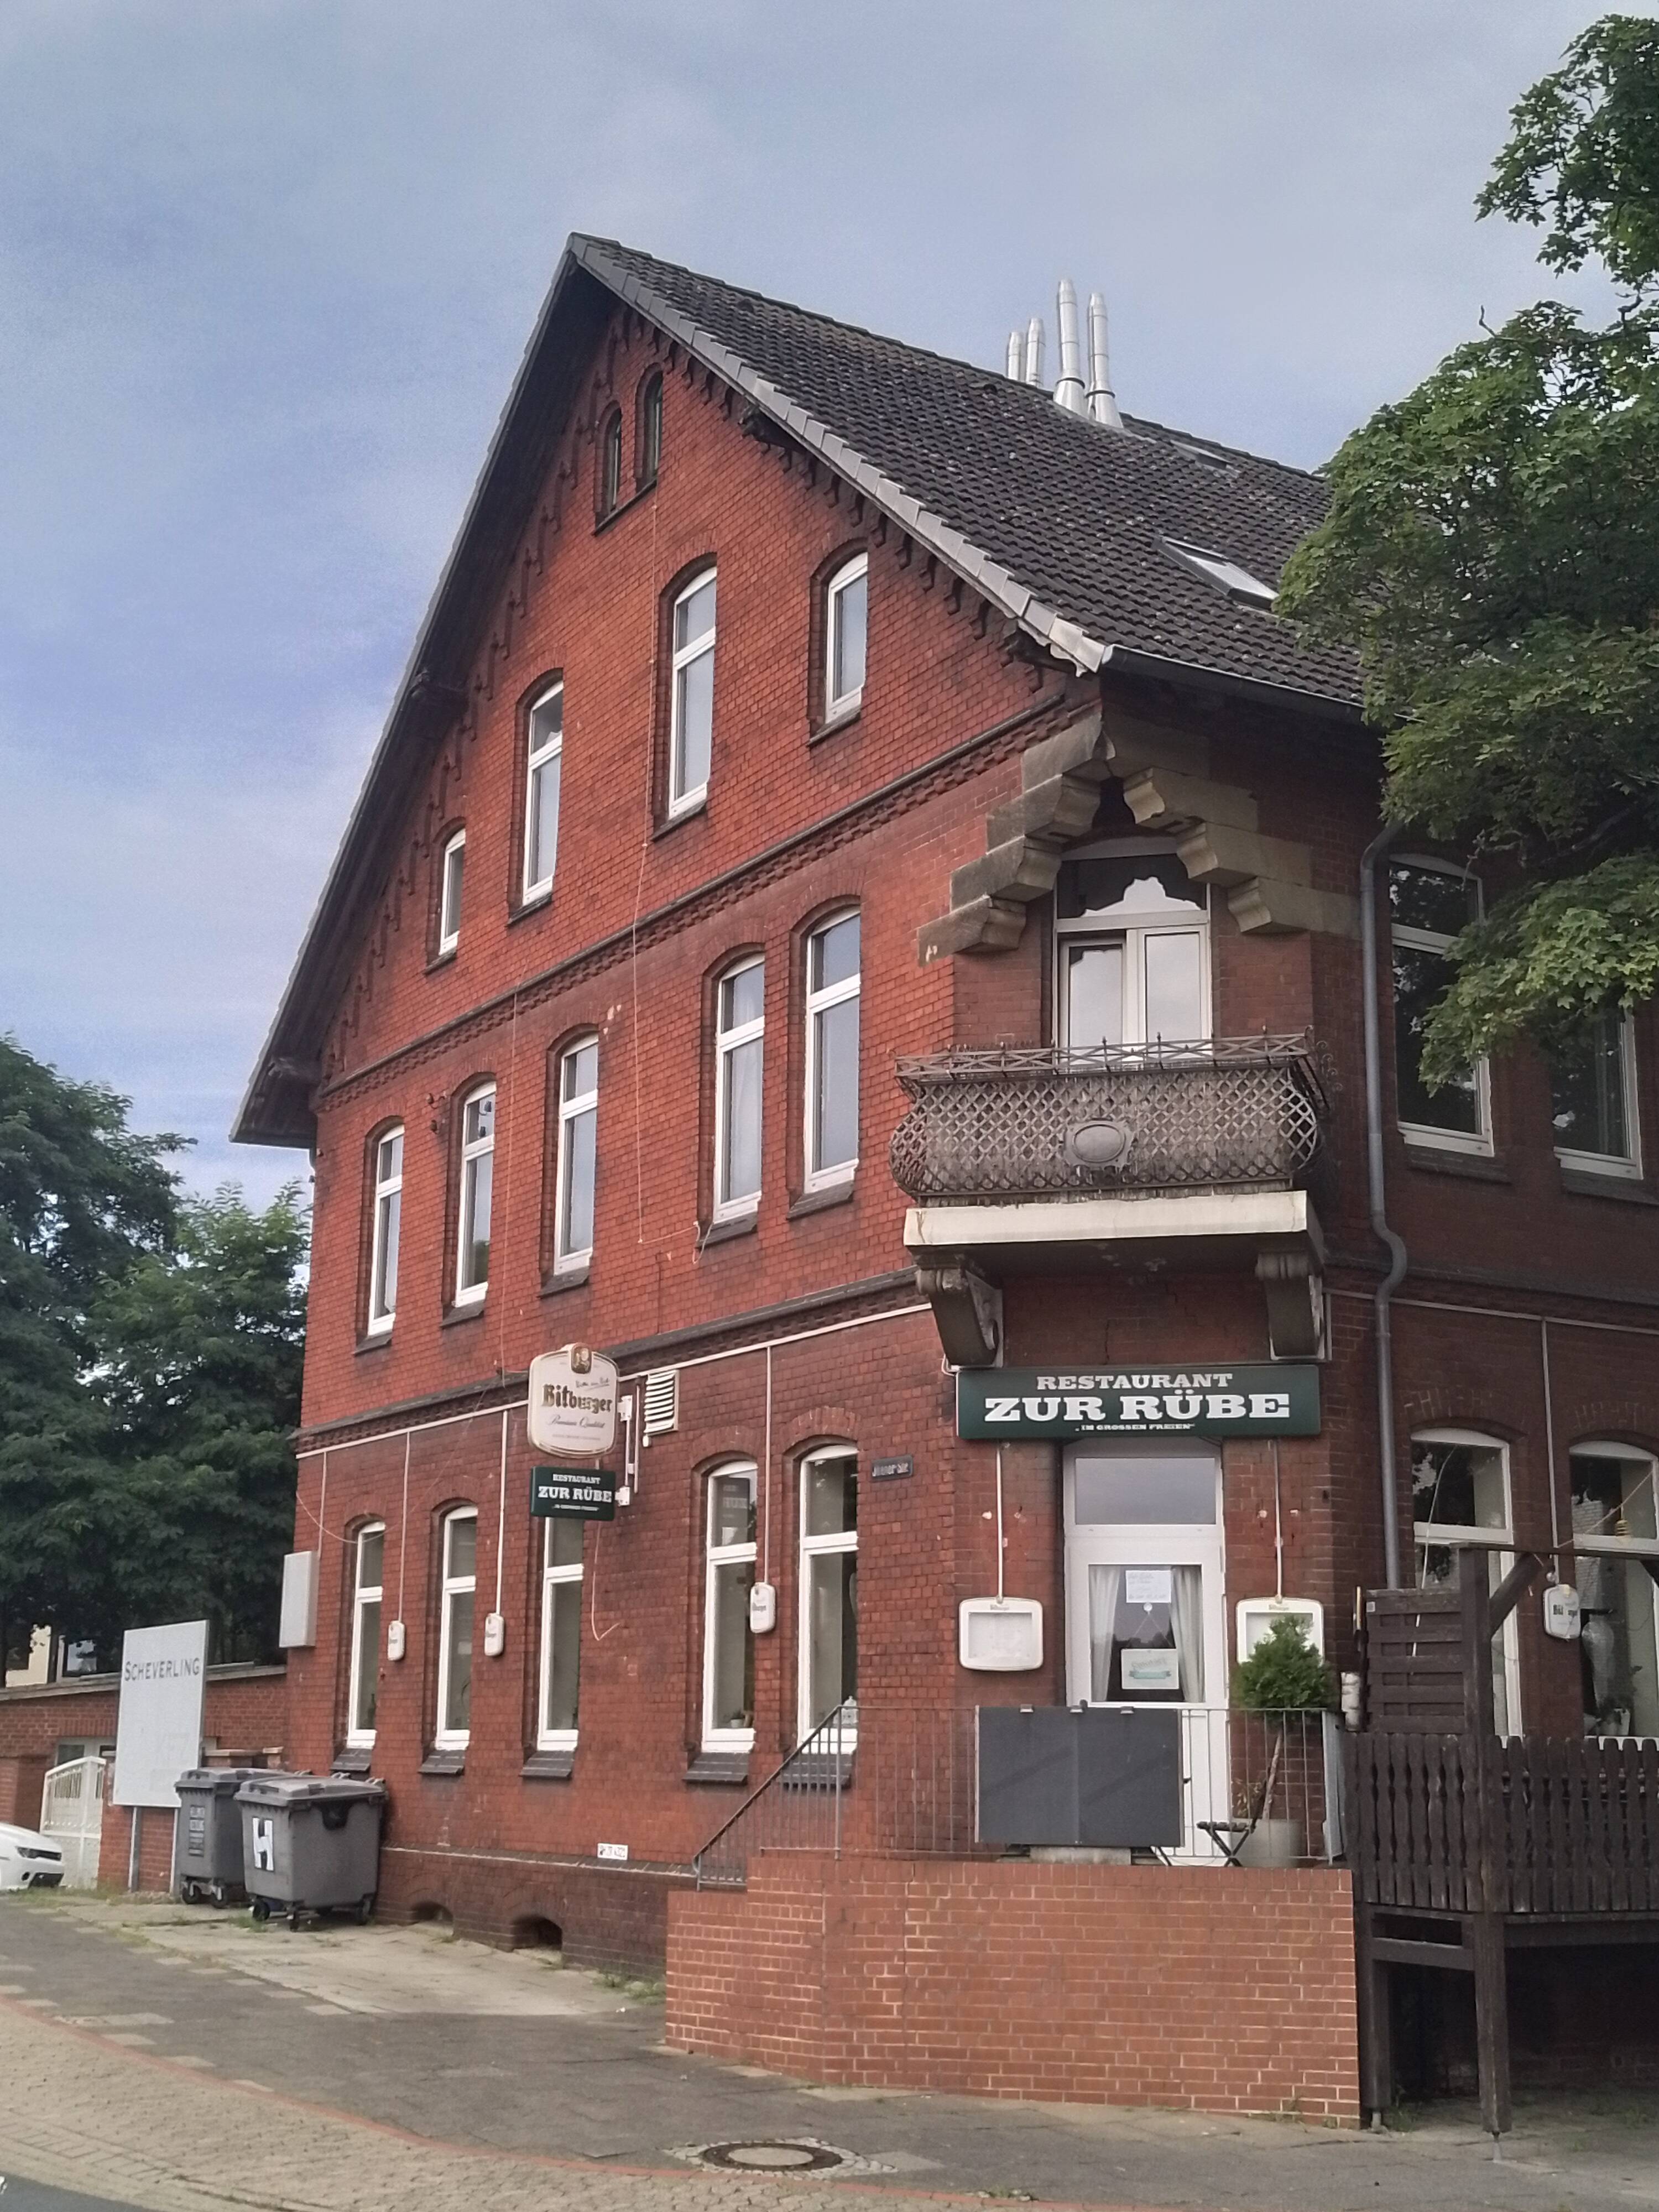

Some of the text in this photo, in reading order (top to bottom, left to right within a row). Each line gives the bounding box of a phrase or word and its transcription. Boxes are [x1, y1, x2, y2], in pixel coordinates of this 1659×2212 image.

[1036, 1373, 1233, 1390] RESTAURANT
[541, 1383, 612, 1414] Bitburger
[984, 1389, 1290, 1422] ZUR RÜBE
[552, 1473, 601, 1485] RESTAURANT
[538, 1485, 612, 1503] ZUR RÜBE
